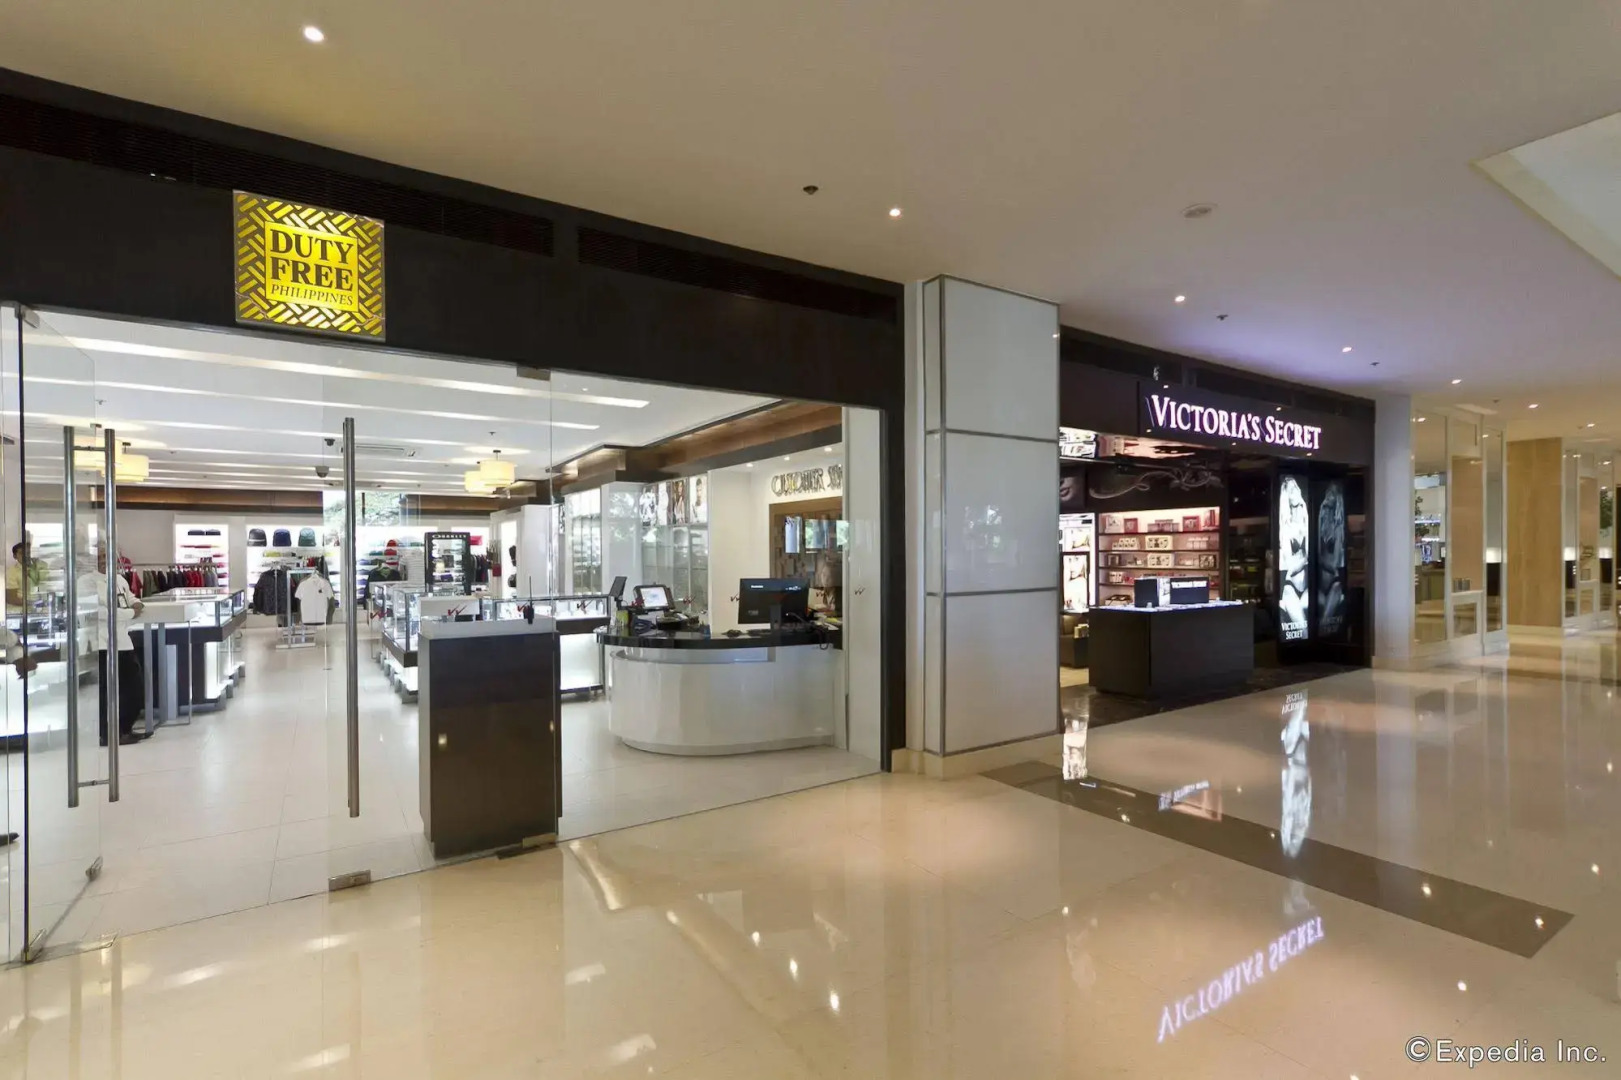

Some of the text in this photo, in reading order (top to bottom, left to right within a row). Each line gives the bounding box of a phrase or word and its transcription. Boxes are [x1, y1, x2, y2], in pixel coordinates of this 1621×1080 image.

[270, 229, 354, 265] DUTY
[270, 256, 354, 292] FREE
[270, 283, 354, 307] PHILIPPINES
[1150, 394, 1322, 449] VICTORIA'S SECRET
